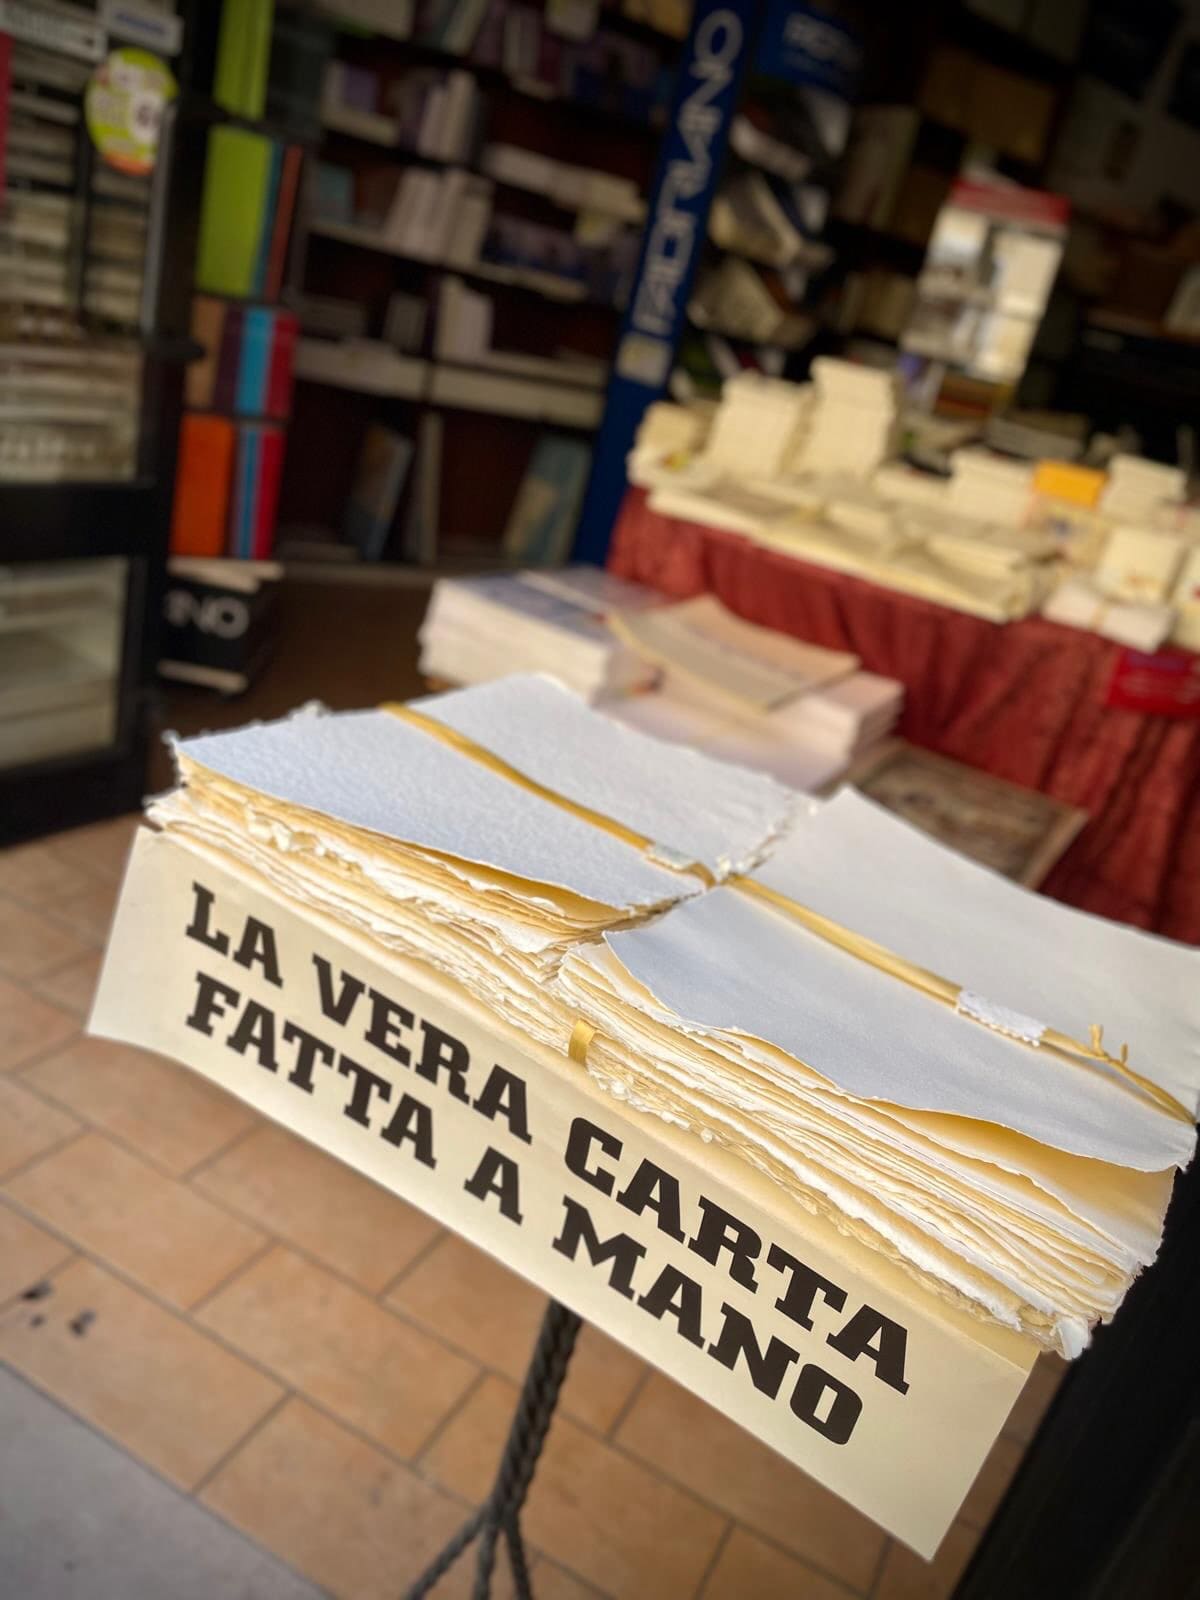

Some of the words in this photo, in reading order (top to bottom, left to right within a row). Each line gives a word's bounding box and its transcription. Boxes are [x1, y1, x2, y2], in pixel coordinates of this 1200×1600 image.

[186, 882, 283, 988] LA
[312, 954, 532, 1145] VERA
[564, 1117, 910, 1396] CARTA
[186, 972, 436, 1169] FATTA
[464, 1146, 523, 1225] A
[552, 1195, 863, 1445] MANO
